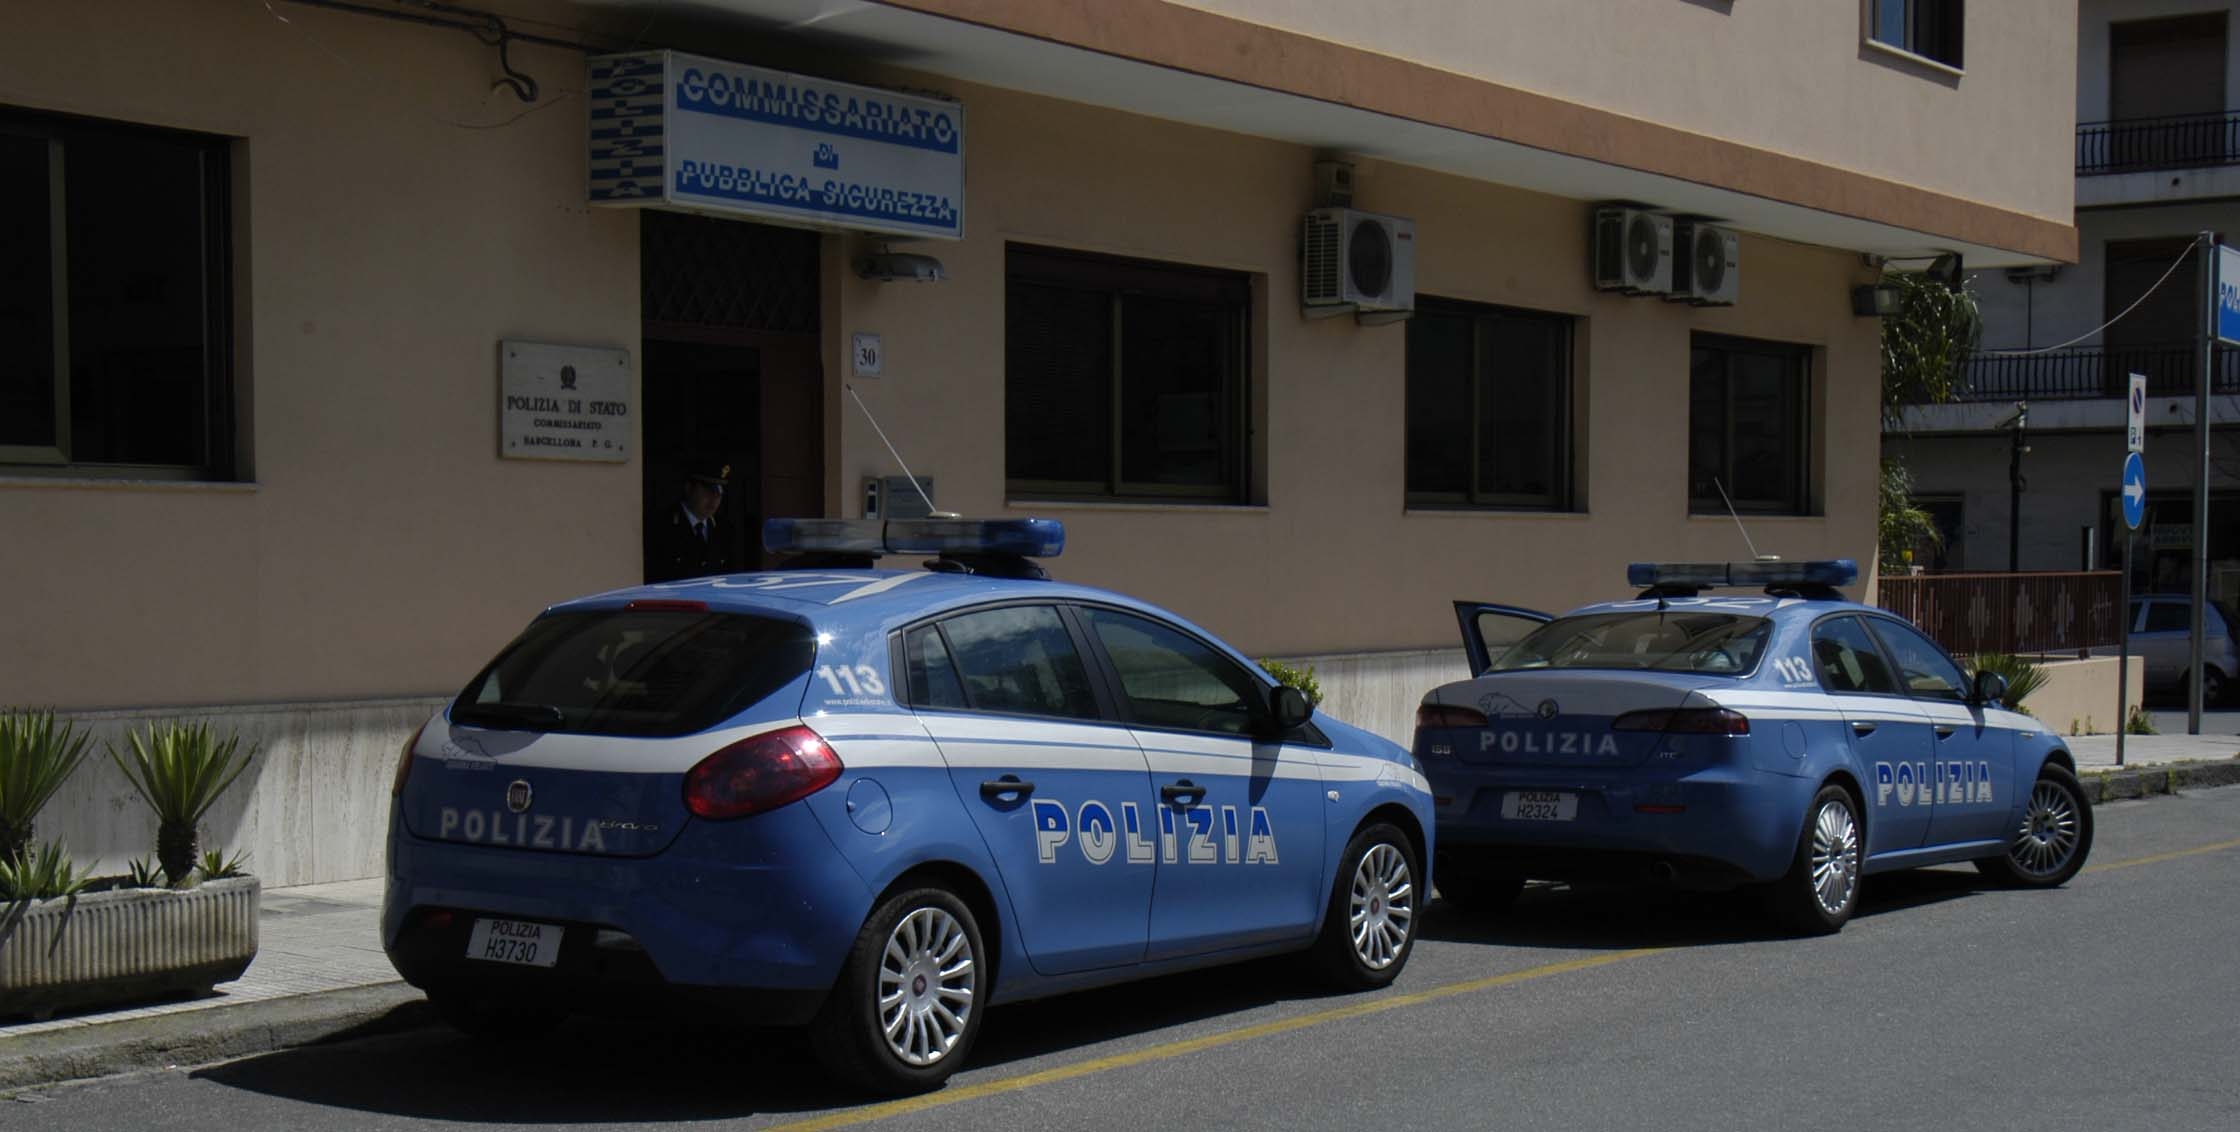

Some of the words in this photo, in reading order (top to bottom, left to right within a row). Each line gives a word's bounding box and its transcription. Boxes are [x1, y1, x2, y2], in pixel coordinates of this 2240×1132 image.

[682, 68, 953, 144] COMMISSARIATO
[608, 58, 648, 199] POLIZIA
[682, 160, 811, 201] PUBBLICA
[823, 180, 953, 221] SICUREZZA
[859, 349, 877, 366] 30
[507, 396, 559, 412] POLIZIA
[568, 400, 581, 414] DI
[590, 402, 627, 416] STATO
[534, 419, 602, 429] COMMISSARIATO
[524, 436, 581, 447] BARCELLONA
[816, 664, 885, 696] 113
[1774, 656, 1813, 682] 113
[1479, 731, 1619, 755] POLIZIA
[1875, 761, 1993, 806] POLIZIA
[1517, 804, 1558, 818] H2324
[440, 806, 607, 851] POLIZIA
[1032, 799, 1280, 865] POLIZIA
[491, 921, 541, 938] POLIZIA
[485, 938, 538, 962] H3730
